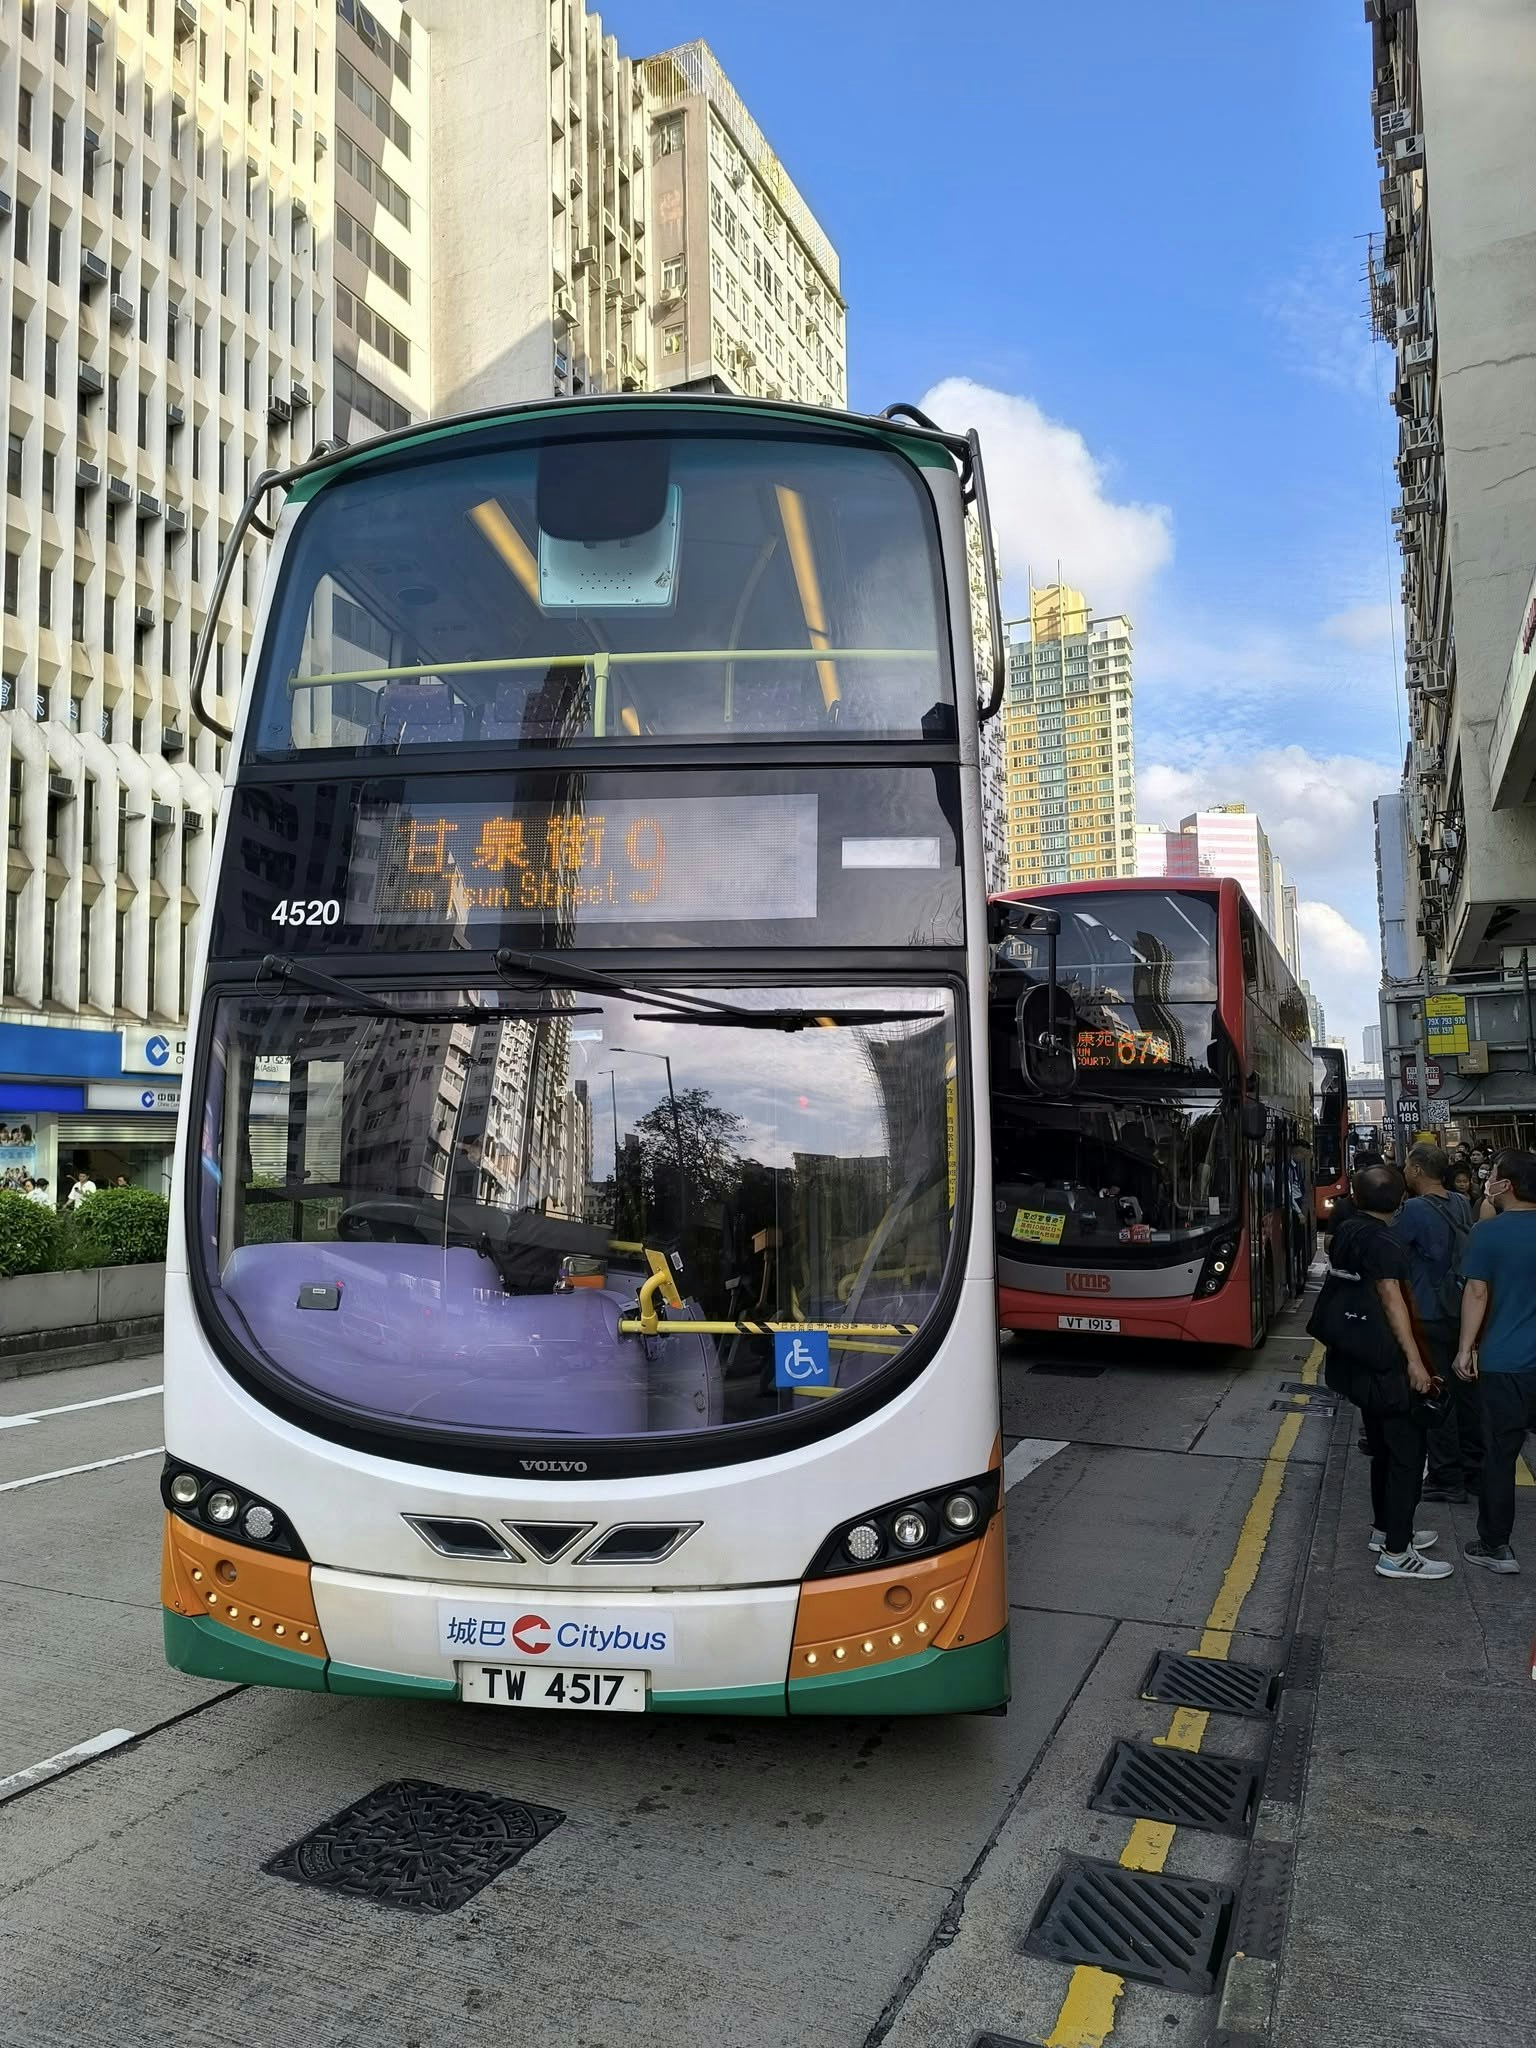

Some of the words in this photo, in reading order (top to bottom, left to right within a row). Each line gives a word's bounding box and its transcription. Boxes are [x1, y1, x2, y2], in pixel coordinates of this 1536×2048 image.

[397, 814, 605, 873] 甘泉街
[521, 870, 619, 907] Street
[271, 899, 340, 926] 4520
[1454, 1016, 1466, 1025] 970
[1399, 1101, 1417, 1112] MK
[1399, 1113, 1419, 1122] 188
[1065, 1272, 1111, 1293] KMB
[1067, 1317, 1083, 1329] VT
[1088, 1319, 1112, 1331] 1913
[520, 1460, 588, 1473] VOLVO
[446, 1616, 506, 1647] 城巴
[556, 1622, 667, 1652] Citybus
[482, 1668, 526, 1701] TW
[544, 1672, 625, 1706] 4517
